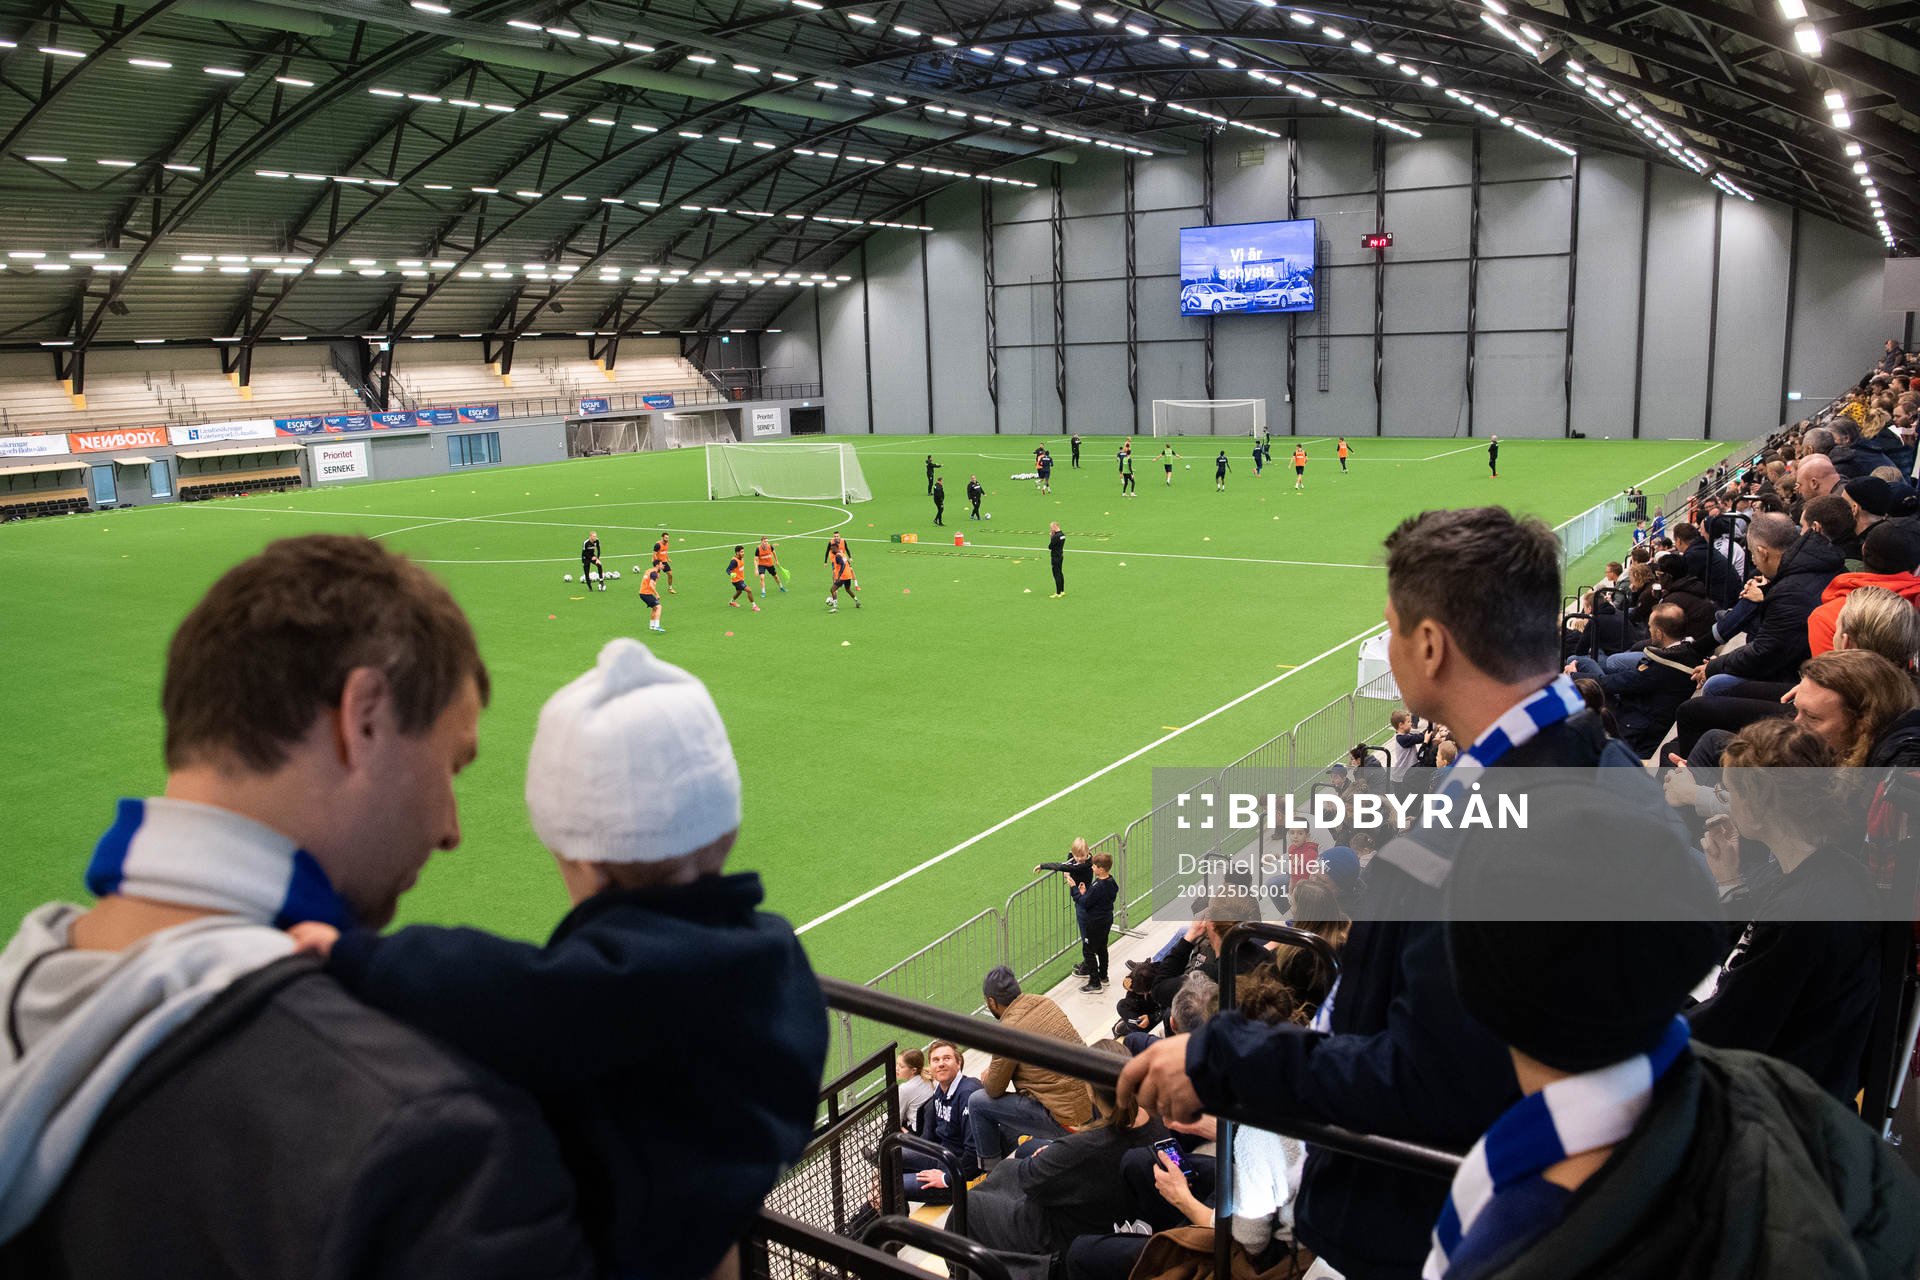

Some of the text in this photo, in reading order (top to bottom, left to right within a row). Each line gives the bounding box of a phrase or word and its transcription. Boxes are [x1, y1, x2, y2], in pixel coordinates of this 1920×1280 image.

[1230, 247, 1263, 261] Vi är
[1219, 264, 1275, 282] schysta
[468, 408, 489, 417] ESCAPE
[382, 414, 406, 422] ESCAPE
[287, 420, 313, 429] ESCAPE
[80, 431, 161, 449] NEWBODY.
[323, 450, 353, 460] Prioritet
[323, 464, 355, 474] SERNEKE
